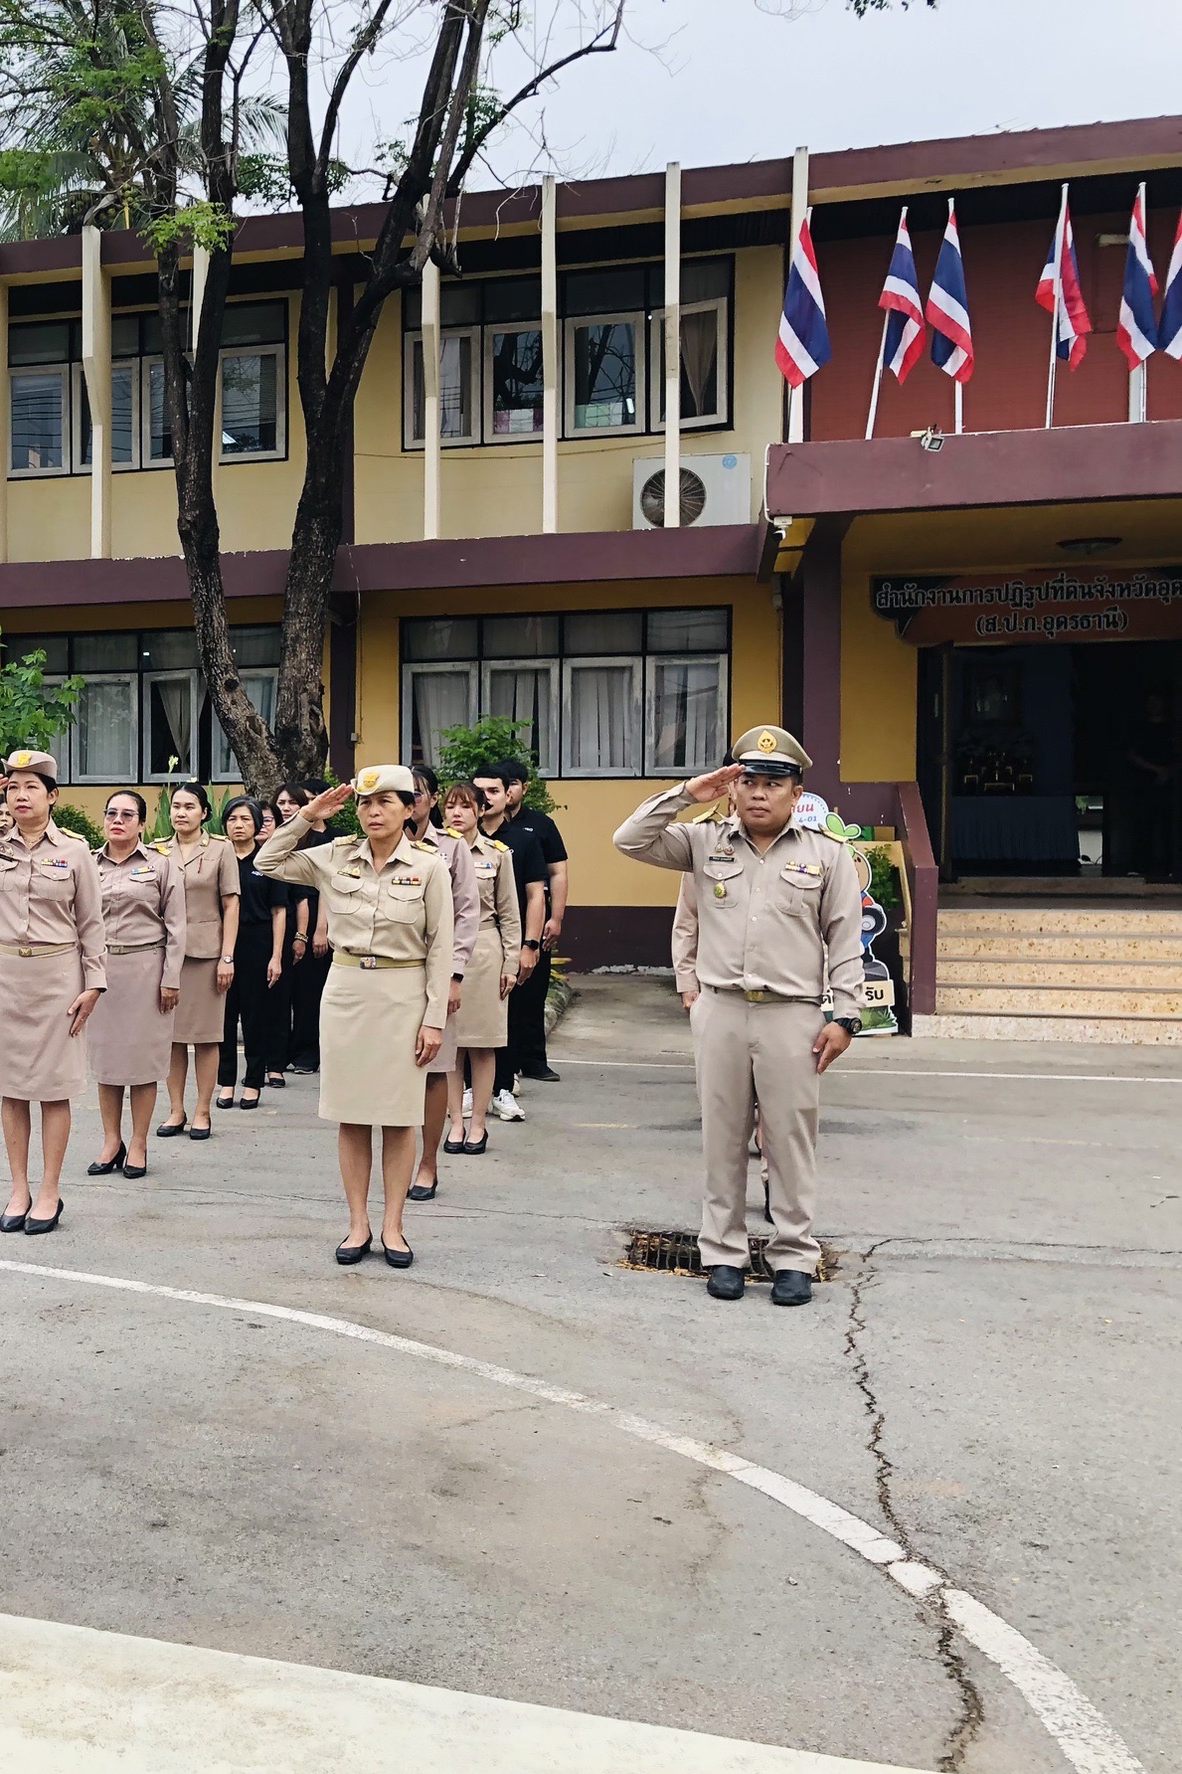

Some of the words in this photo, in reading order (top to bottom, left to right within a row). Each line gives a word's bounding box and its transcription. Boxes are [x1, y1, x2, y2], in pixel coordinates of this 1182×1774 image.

[975, 605, 1129, 639] (ส.ป.ก.อุดรธานี)
